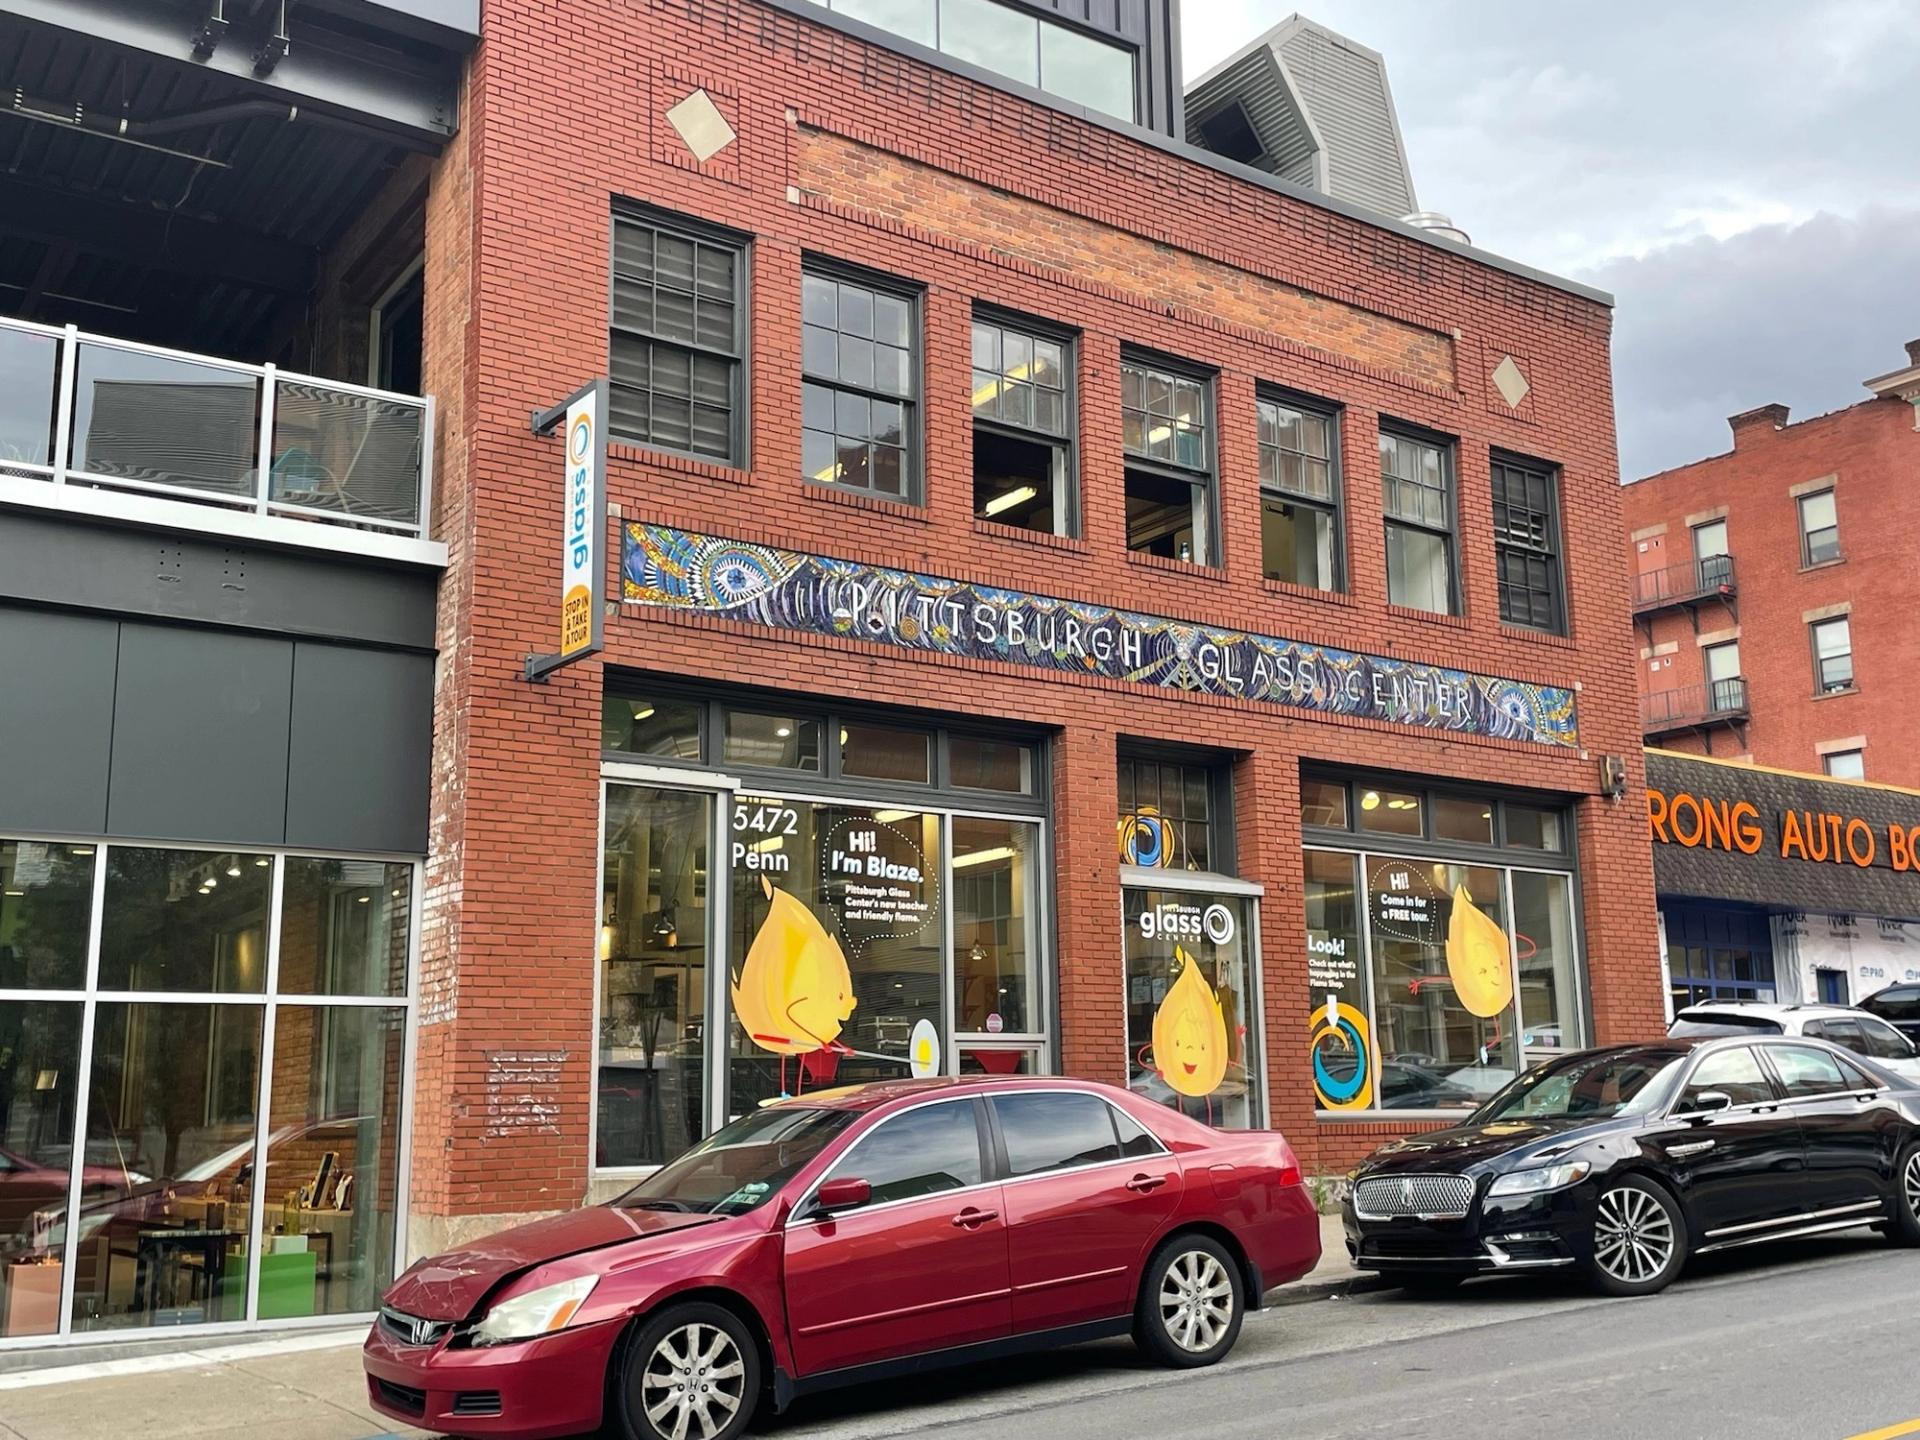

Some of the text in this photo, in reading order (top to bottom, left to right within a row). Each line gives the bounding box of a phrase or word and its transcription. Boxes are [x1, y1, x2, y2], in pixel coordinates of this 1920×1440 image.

[569, 468, 588, 570] glass
[565, 595, 589, 617] STOP IN
[572, 610, 587, 628] TAKE
[571, 626, 587, 644] TOUR
[852, 582, 1472, 721] PITTSBURGH GLASS CENTER
[732, 805, 798, 835] 5472
[849, 831, 877, 852] Hi!
[1781, 809, 1876, 867] AUTO
[732, 842, 789, 872] Penn
[831, 850, 924, 884] I'm Blaze.
[1390, 872, 1410, 890] Hi!
[845, 885, 911, 898] Pittsburgh Glass
[1381, 894, 1427, 908] Come in for
[845, 897, 928, 911] Center's new teacher
[845, 910, 920, 923] and friendly flame.
[1140, 904, 1202, 938] glass
[1382, 909, 1430, 922] a FREE tour.
[1157, 934, 1201, 942] CENTER
[1308, 935, 1345, 956] Look!
[1309, 959, 1327, 967] Check
